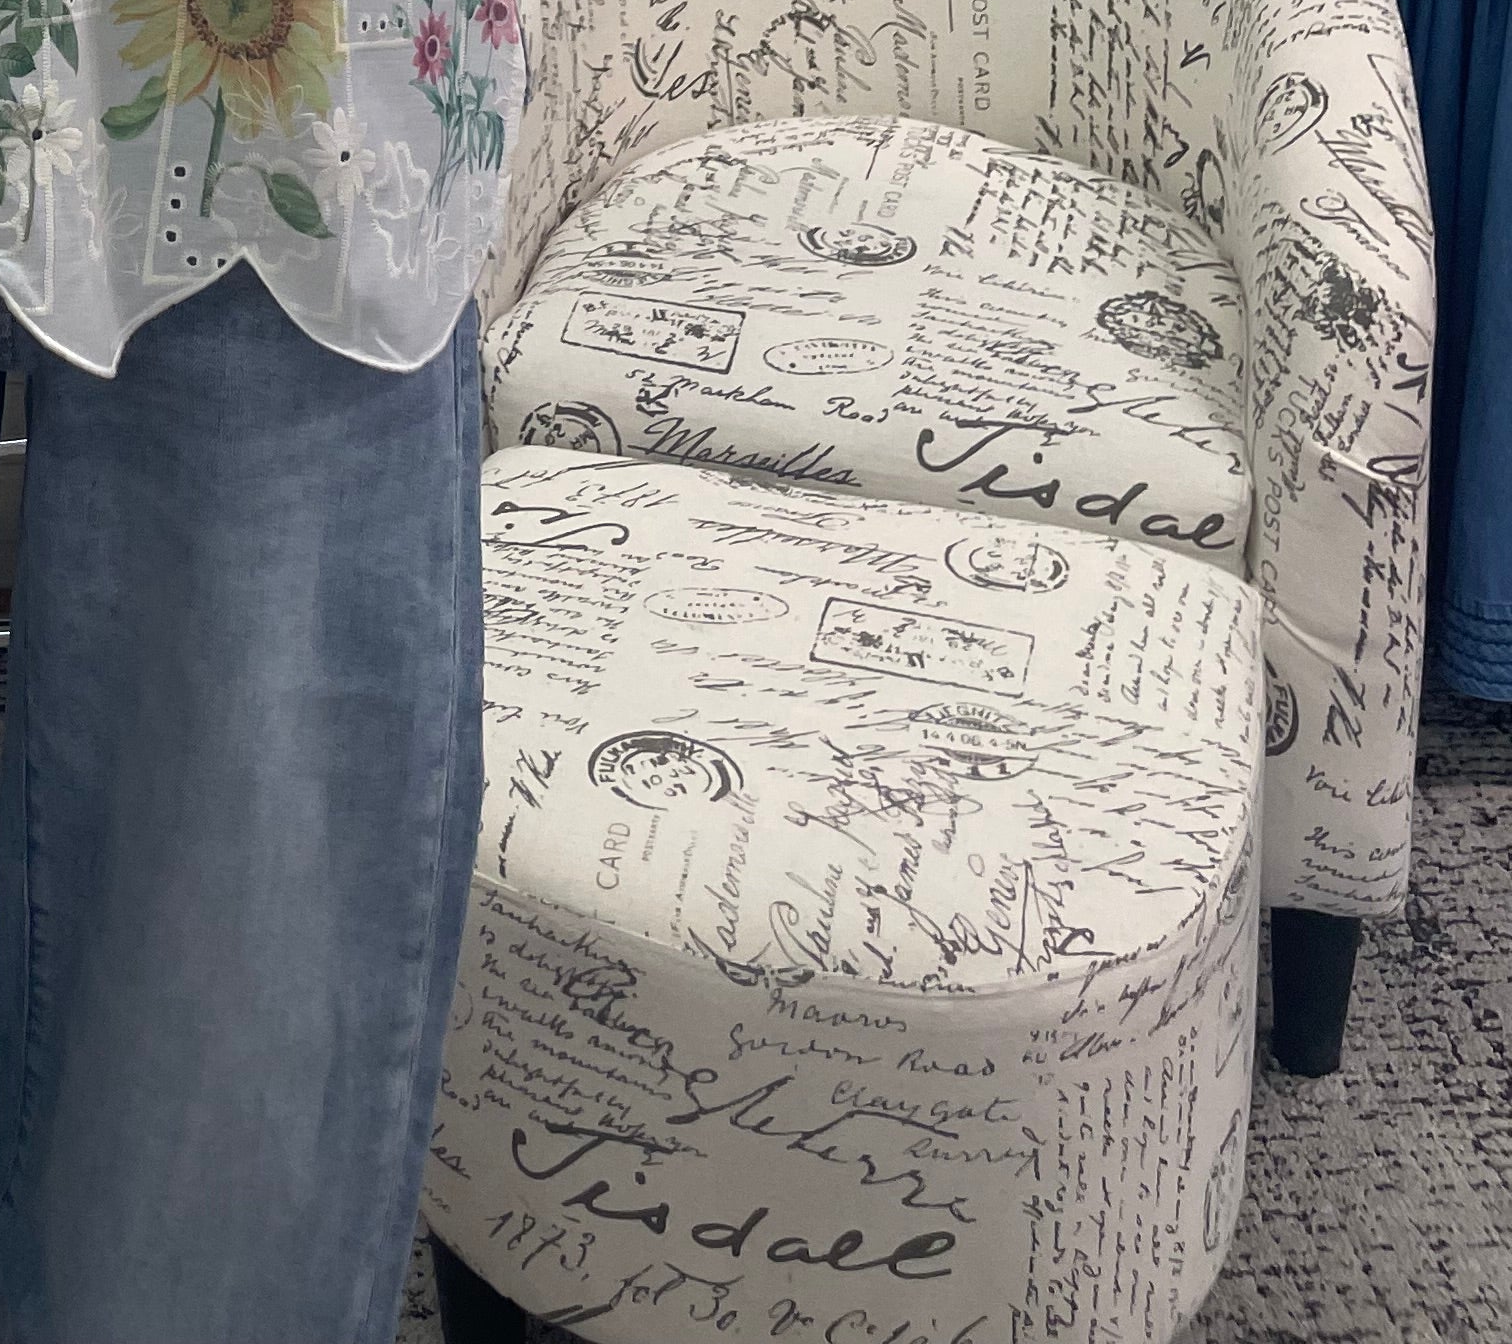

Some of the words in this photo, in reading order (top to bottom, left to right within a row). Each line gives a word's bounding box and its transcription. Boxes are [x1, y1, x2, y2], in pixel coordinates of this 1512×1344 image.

[972, 52, 991, 112] CARD
[1261, 475, 1281, 553] POST
[595, 821, 631, 891] CARD
